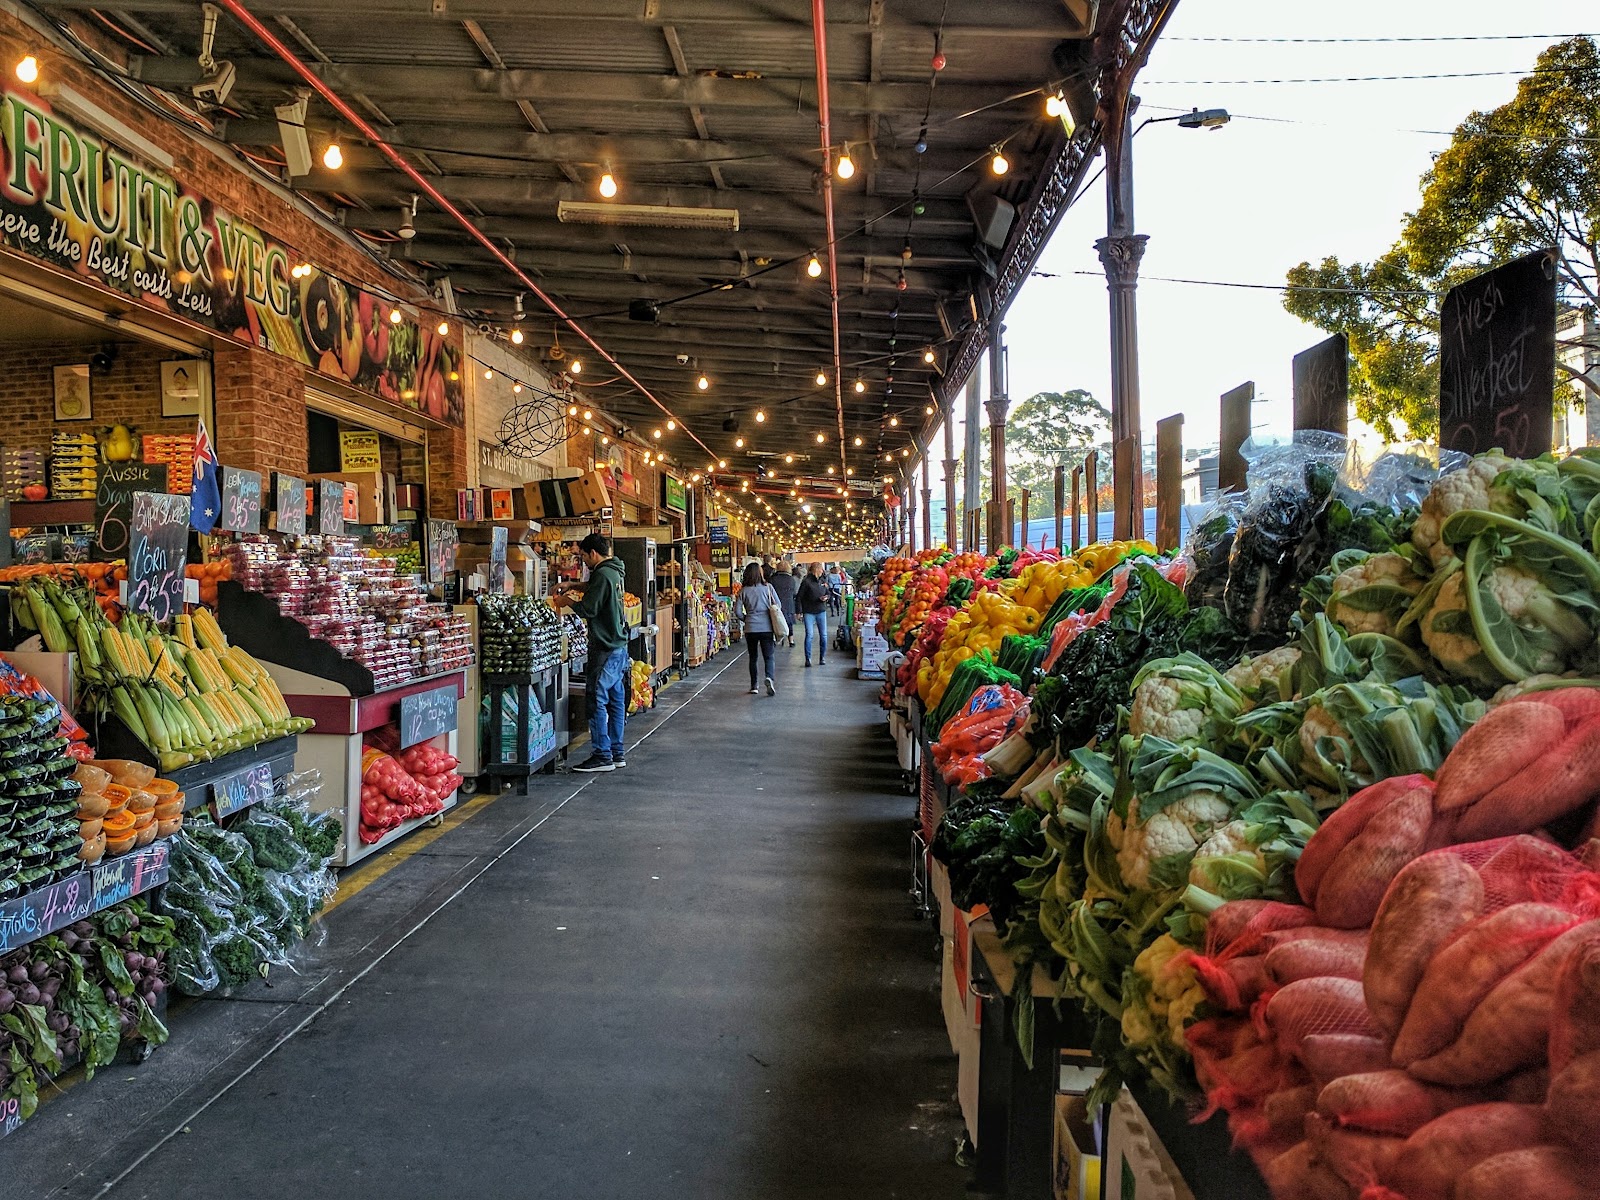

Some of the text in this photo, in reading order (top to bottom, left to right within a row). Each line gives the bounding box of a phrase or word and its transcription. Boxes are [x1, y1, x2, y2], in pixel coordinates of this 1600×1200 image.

[7, 95, 291, 317] FRUIT & VEG
[0, 208, 213, 317] ere the Best costs Less
[711, 546, 730, 557] myki
